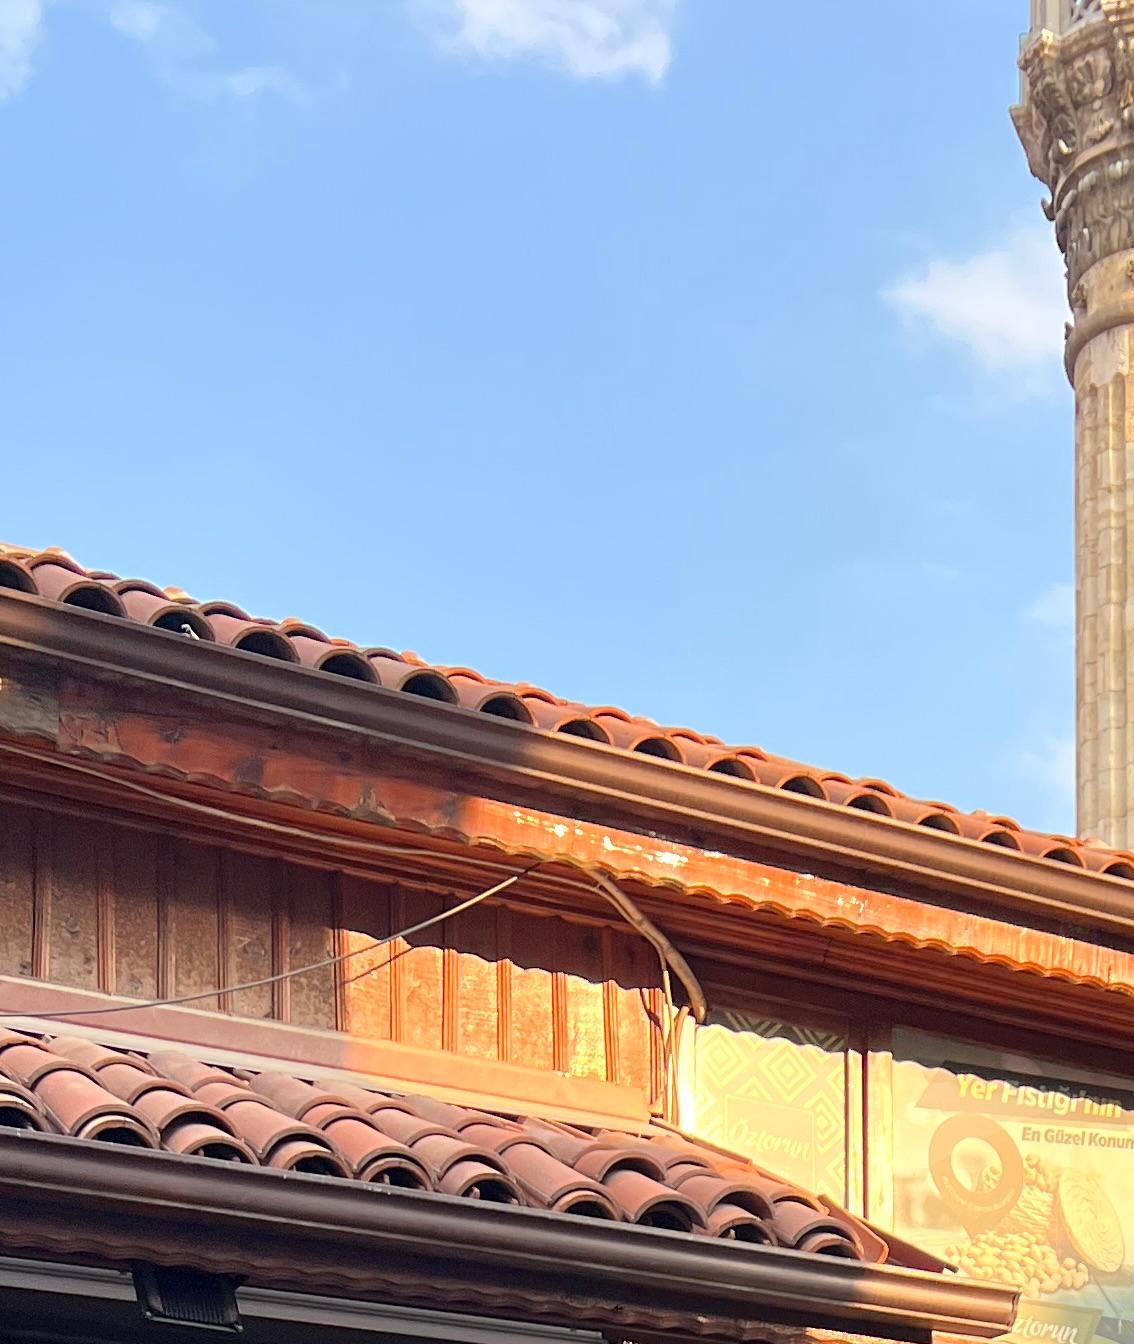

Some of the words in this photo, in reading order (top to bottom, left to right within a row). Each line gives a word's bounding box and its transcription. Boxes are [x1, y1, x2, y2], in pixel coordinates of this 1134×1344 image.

[956, 1073, 998, 1102] Yer
[1021, 1126, 1041, 1142] En
[1044, 1129, 1086, 1147] Güzel
